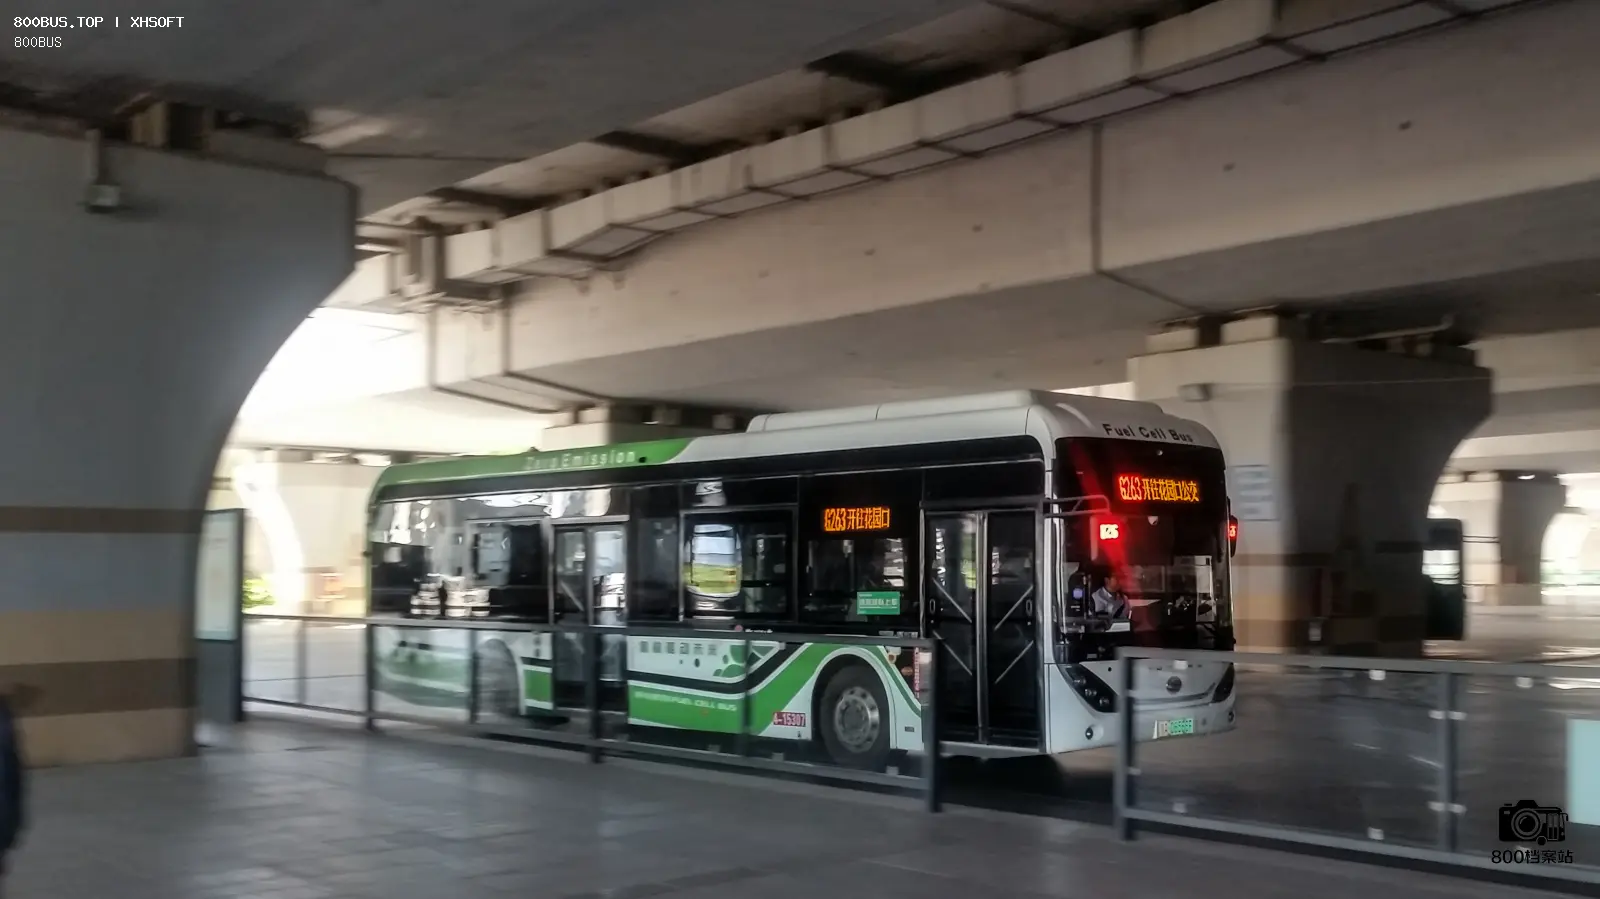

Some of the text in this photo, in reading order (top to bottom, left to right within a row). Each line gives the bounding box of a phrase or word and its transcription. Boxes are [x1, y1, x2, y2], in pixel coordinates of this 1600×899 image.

[1102, 423, 1194, 443] Fuel Cell Bus
[560, 449, 636, 468] Emission
